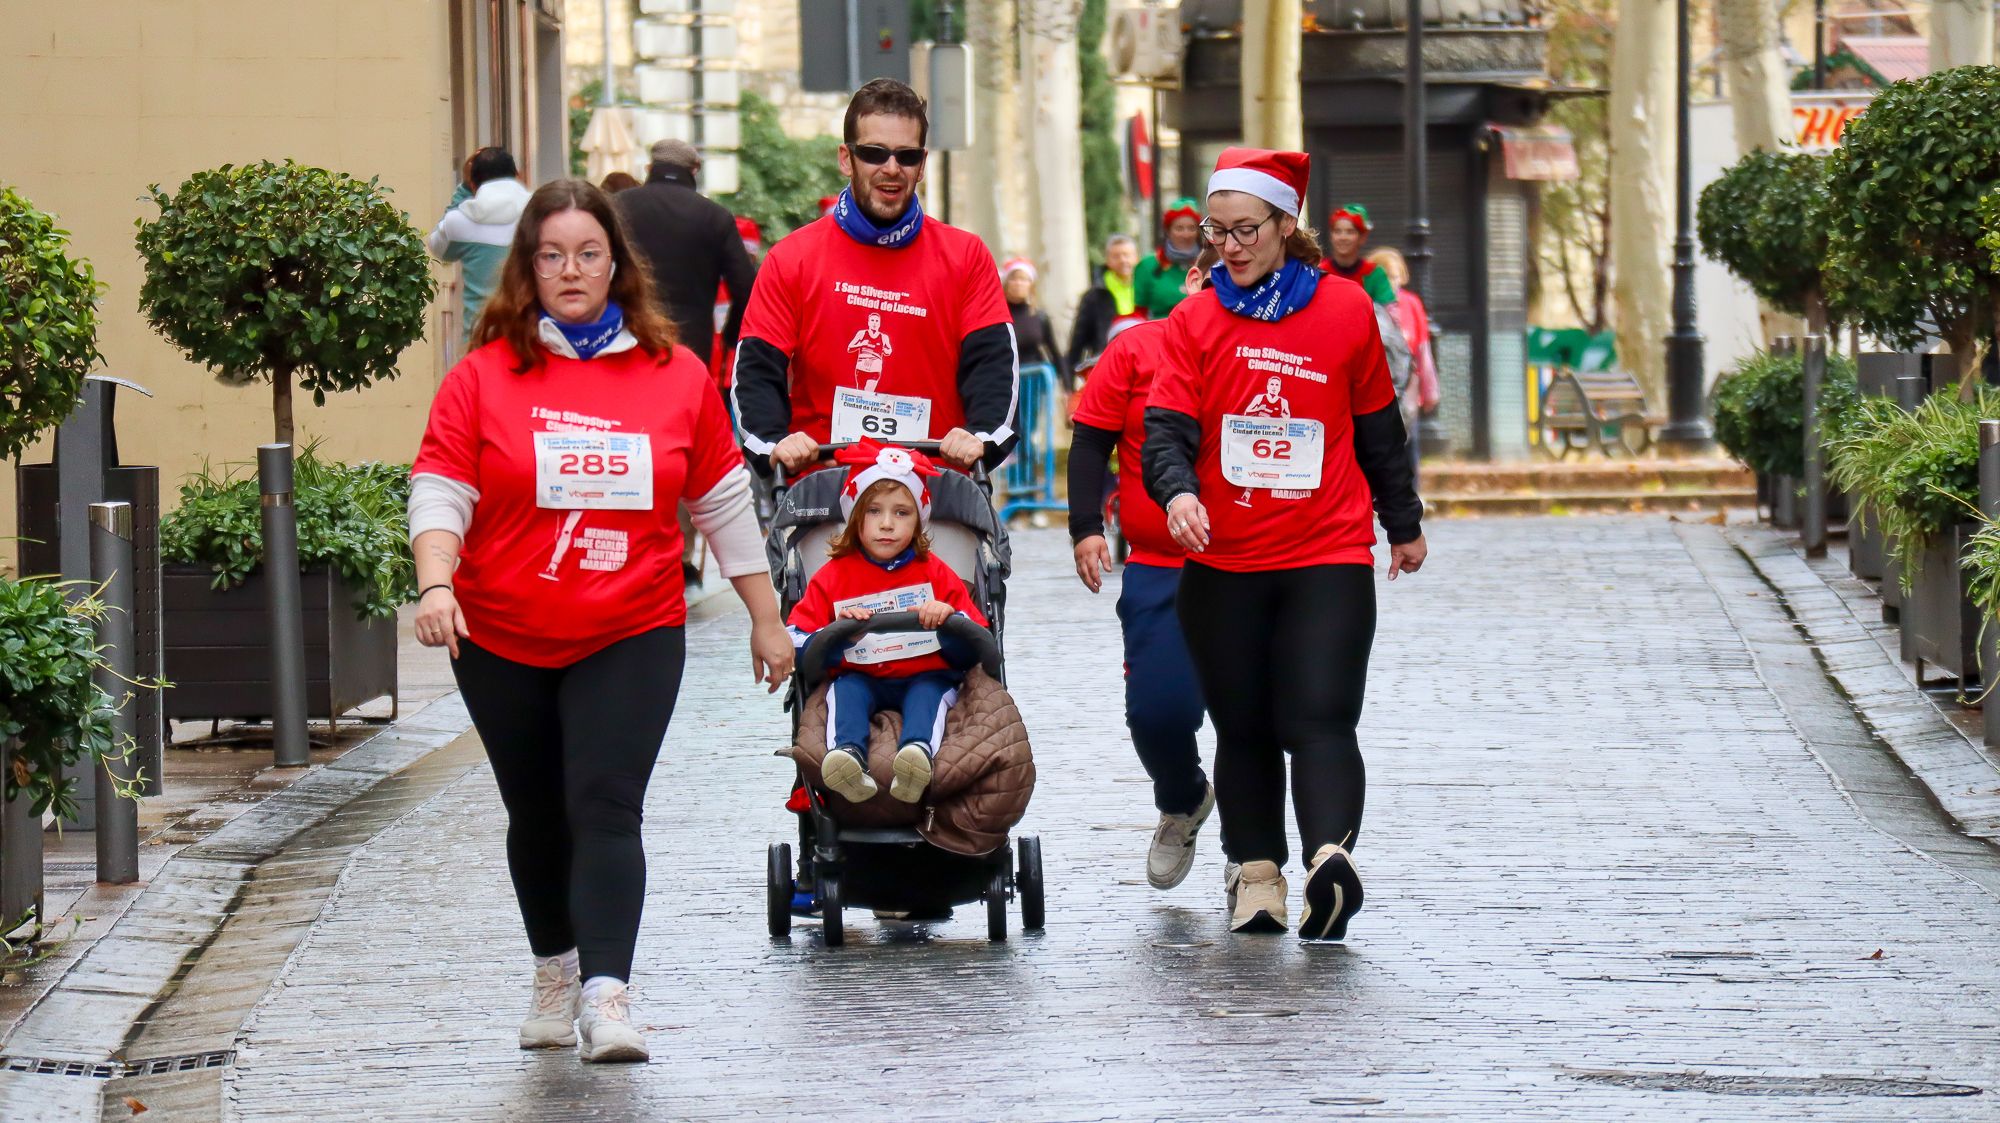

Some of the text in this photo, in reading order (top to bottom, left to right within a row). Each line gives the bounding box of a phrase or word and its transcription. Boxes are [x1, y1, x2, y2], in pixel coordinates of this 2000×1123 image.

[841, 282, 860, 294] San
[860, 285, 901, 301] Silvestre
[846, 294, 927, 318] Ciudad de Lucena
[1242, 346, 1261, 358] San
[1262, 347, 1303, 365] Silvestre
[1248, 359, 1327, 384] Ciudad de Lucena
[539, 408, 561, 421] San
[861, 414, 898, 436] 63
[1252, 438, 1292, 460] 62
[560, 454, 629, 476] 285
[584, 527, 628, 542] MEMORIAL
[573, 537, 628, 552] JOSE CARLOS
[586, 549, 628, 563] HURTADO
